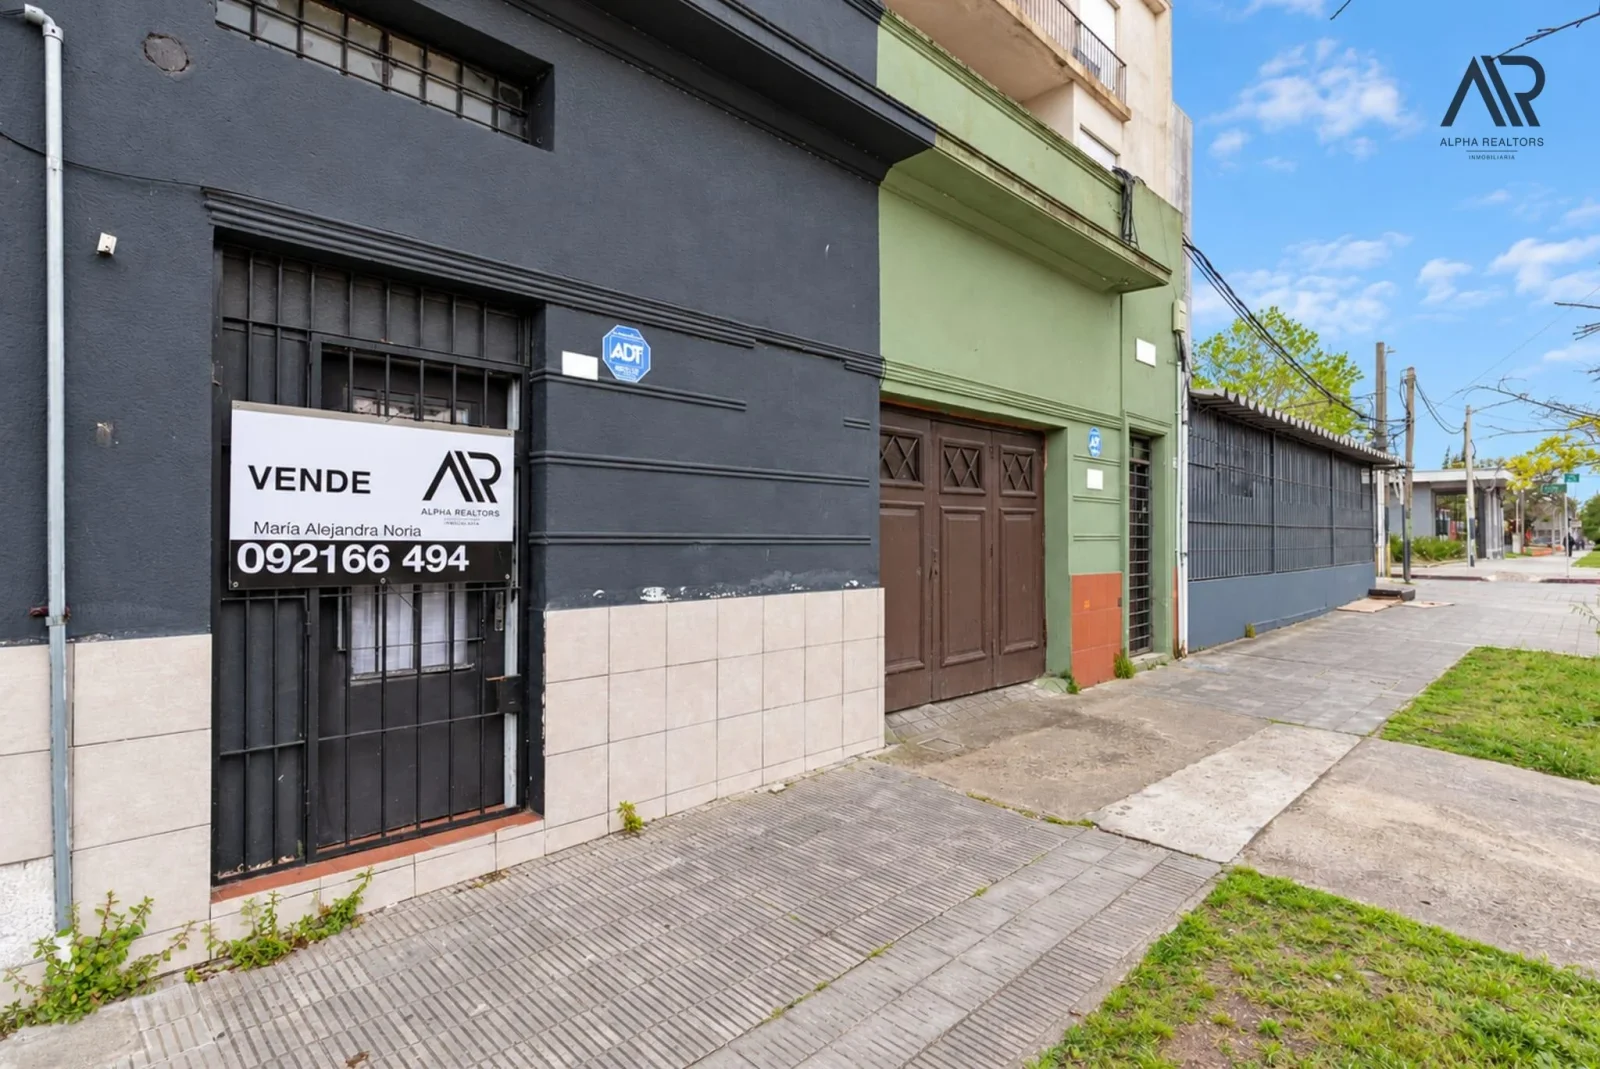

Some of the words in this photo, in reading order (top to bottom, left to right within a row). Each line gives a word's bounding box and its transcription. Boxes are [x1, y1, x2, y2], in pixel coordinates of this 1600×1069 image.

[610, 342, 644, 365] ADT
[248, 465, 371, 494] VENDE
[421, 508, 451, 516] ALPHA
[455, 508, 500, 517] REALTORS
[254, 521, 300, 536] María
[305, 523, 378, 539] Alejandra
[383, 524, 421, 537] Noria
[402, 544, 469, 572] 494
